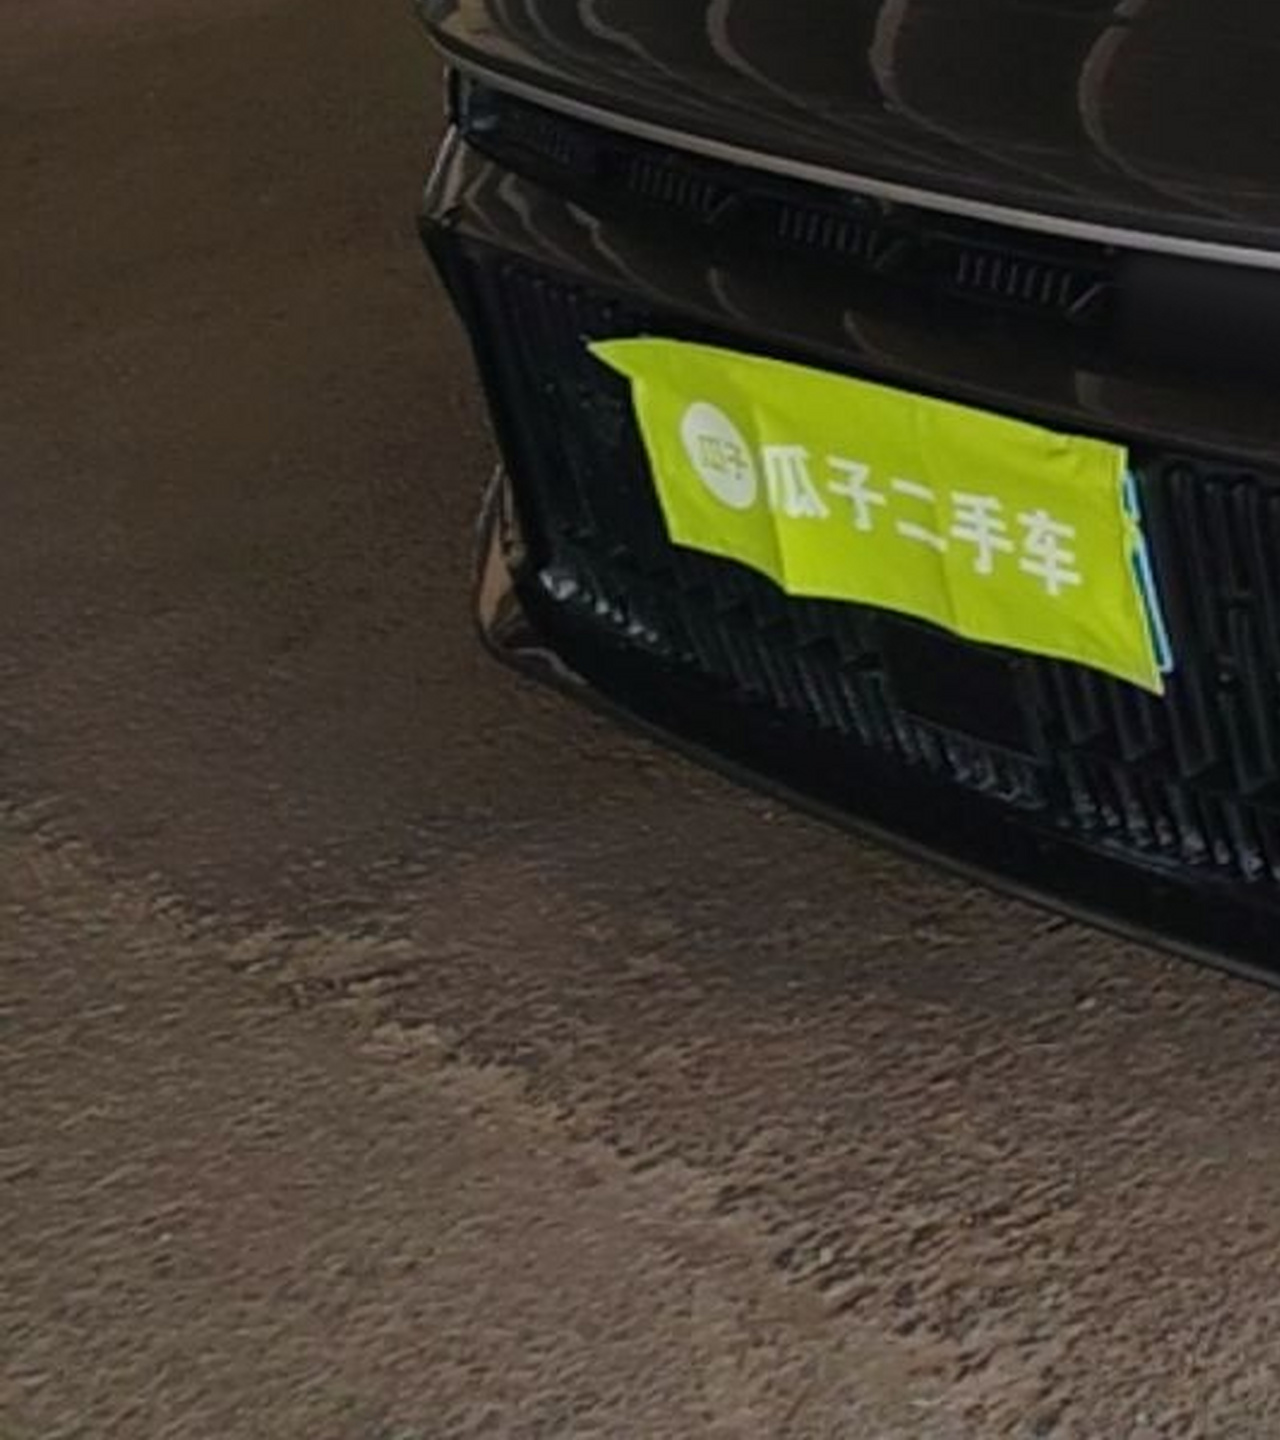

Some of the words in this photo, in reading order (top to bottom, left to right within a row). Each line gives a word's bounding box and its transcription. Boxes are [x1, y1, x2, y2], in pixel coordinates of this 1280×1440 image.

[760, 443, 1083, 596] 瓜子二手车
